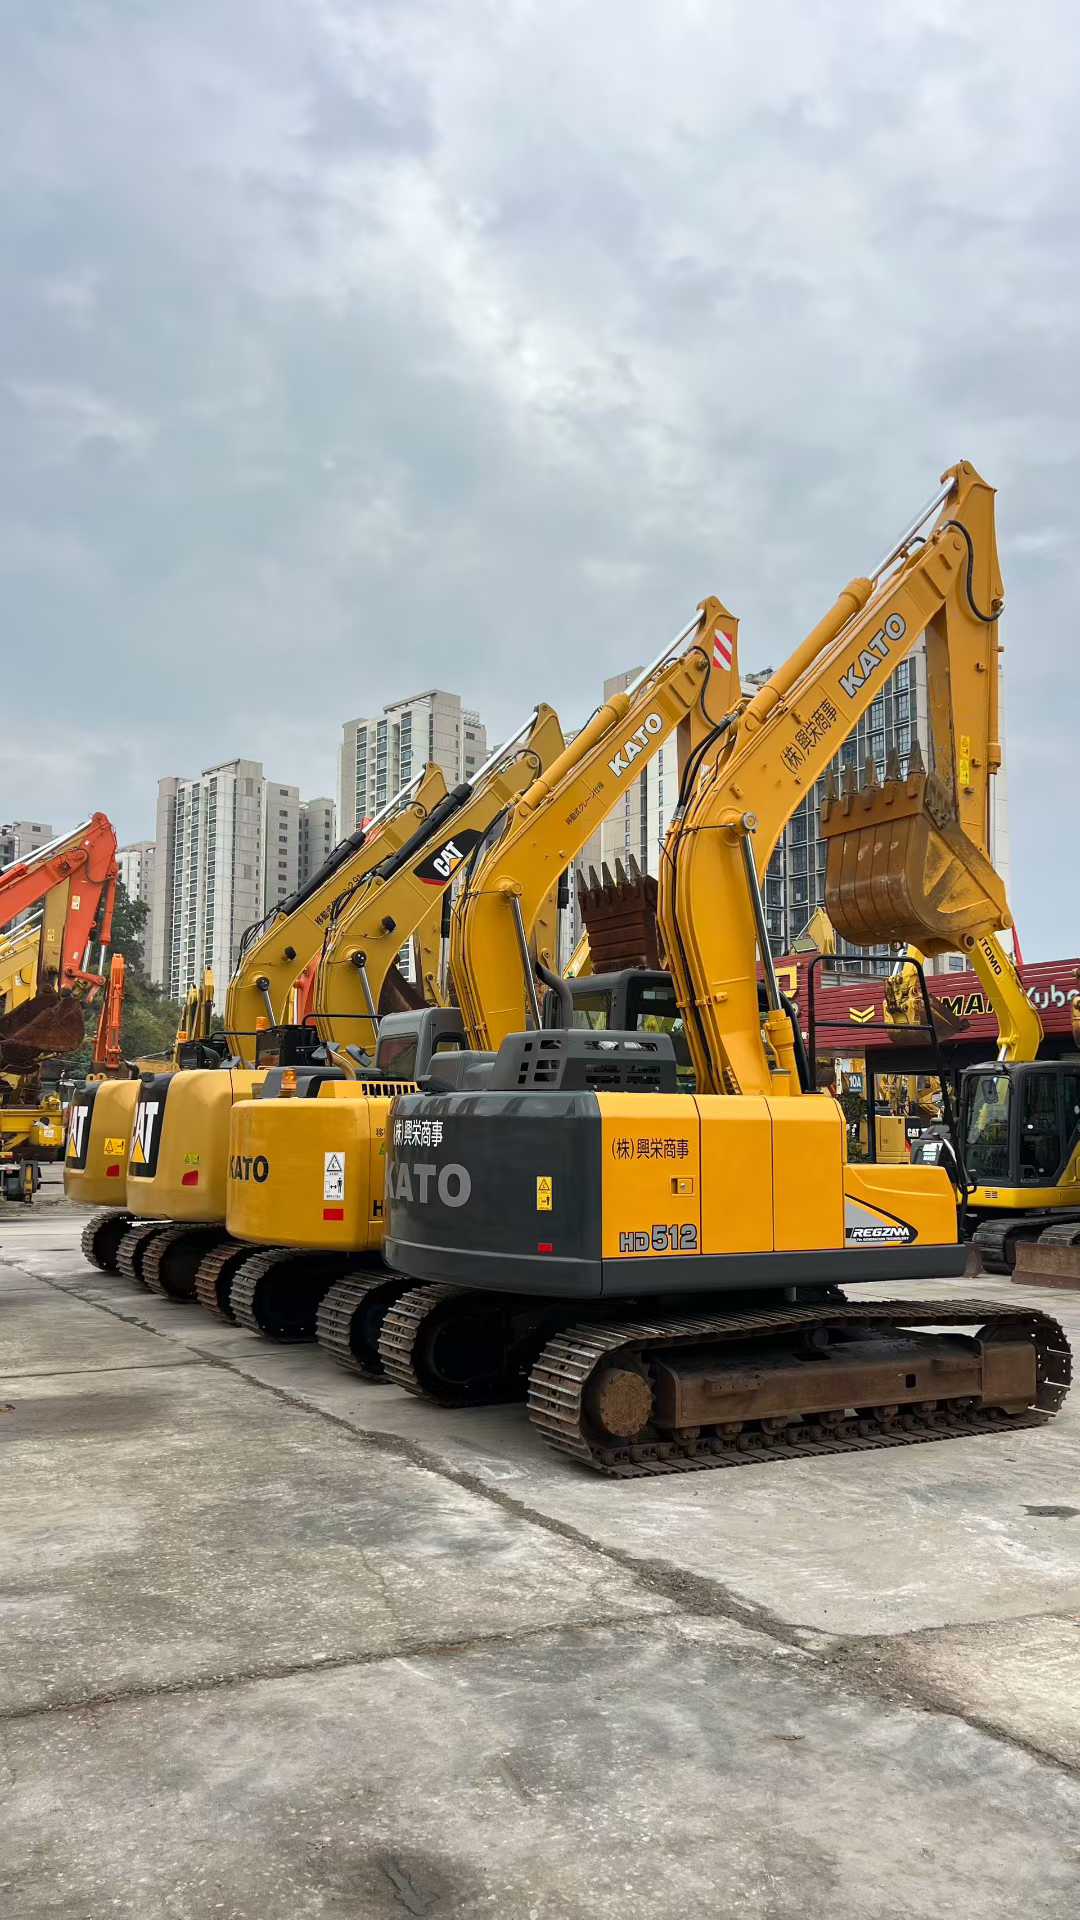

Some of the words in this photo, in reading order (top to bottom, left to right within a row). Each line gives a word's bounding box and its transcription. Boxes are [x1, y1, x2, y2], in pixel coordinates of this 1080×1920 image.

[839, 613, 906, 698] KATO
[608, 713, 662, 777] KATO
[433, 841, 463, 876] CAT
[612, 1138, 689, 1159] (株)興栄商事
[908, 1128, 919, 1137] CAT
[619, 1223, 698, 1252] HD512
